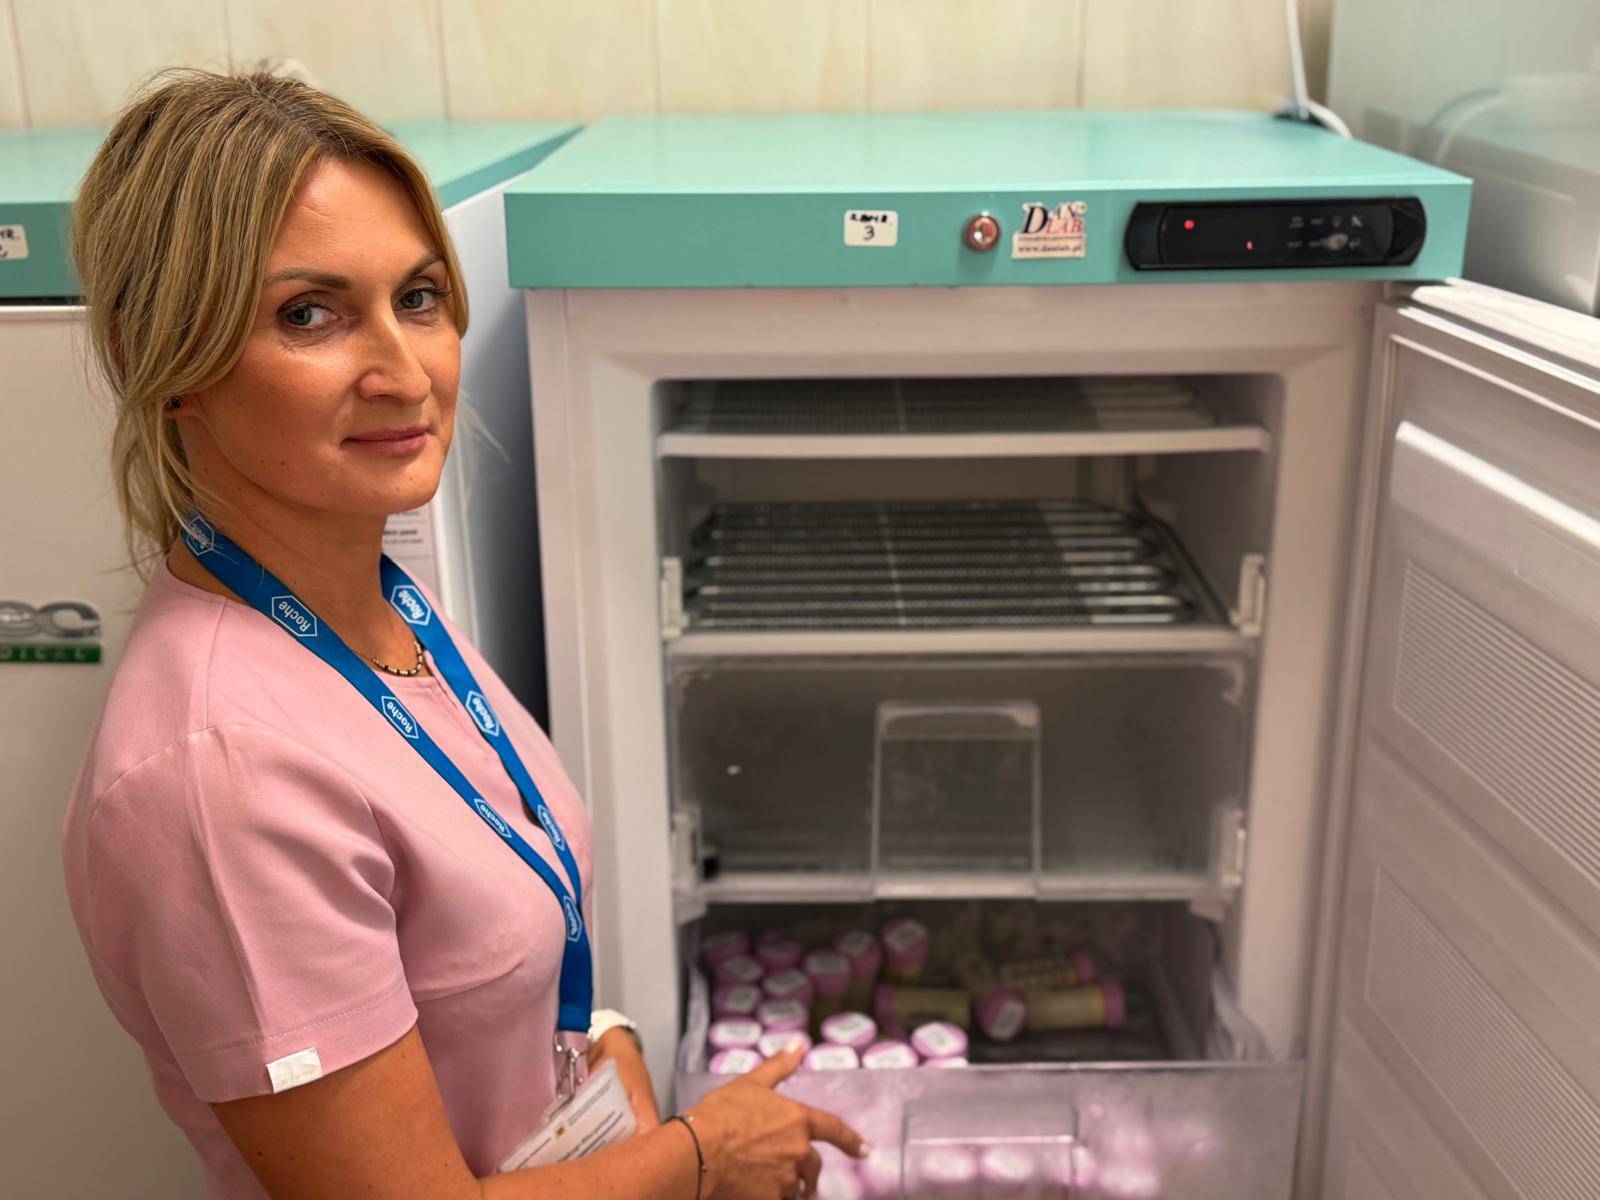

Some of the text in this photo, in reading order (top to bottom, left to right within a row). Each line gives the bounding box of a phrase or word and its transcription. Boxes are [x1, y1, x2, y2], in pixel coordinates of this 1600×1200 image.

[863, 225, 875, 242] 3
[279, 601, 311, 632] Roche
[398, 590, 425, 619] Roche
[387, 701, 413, 733] Roche
[480, 804, 505, 833] Roche
